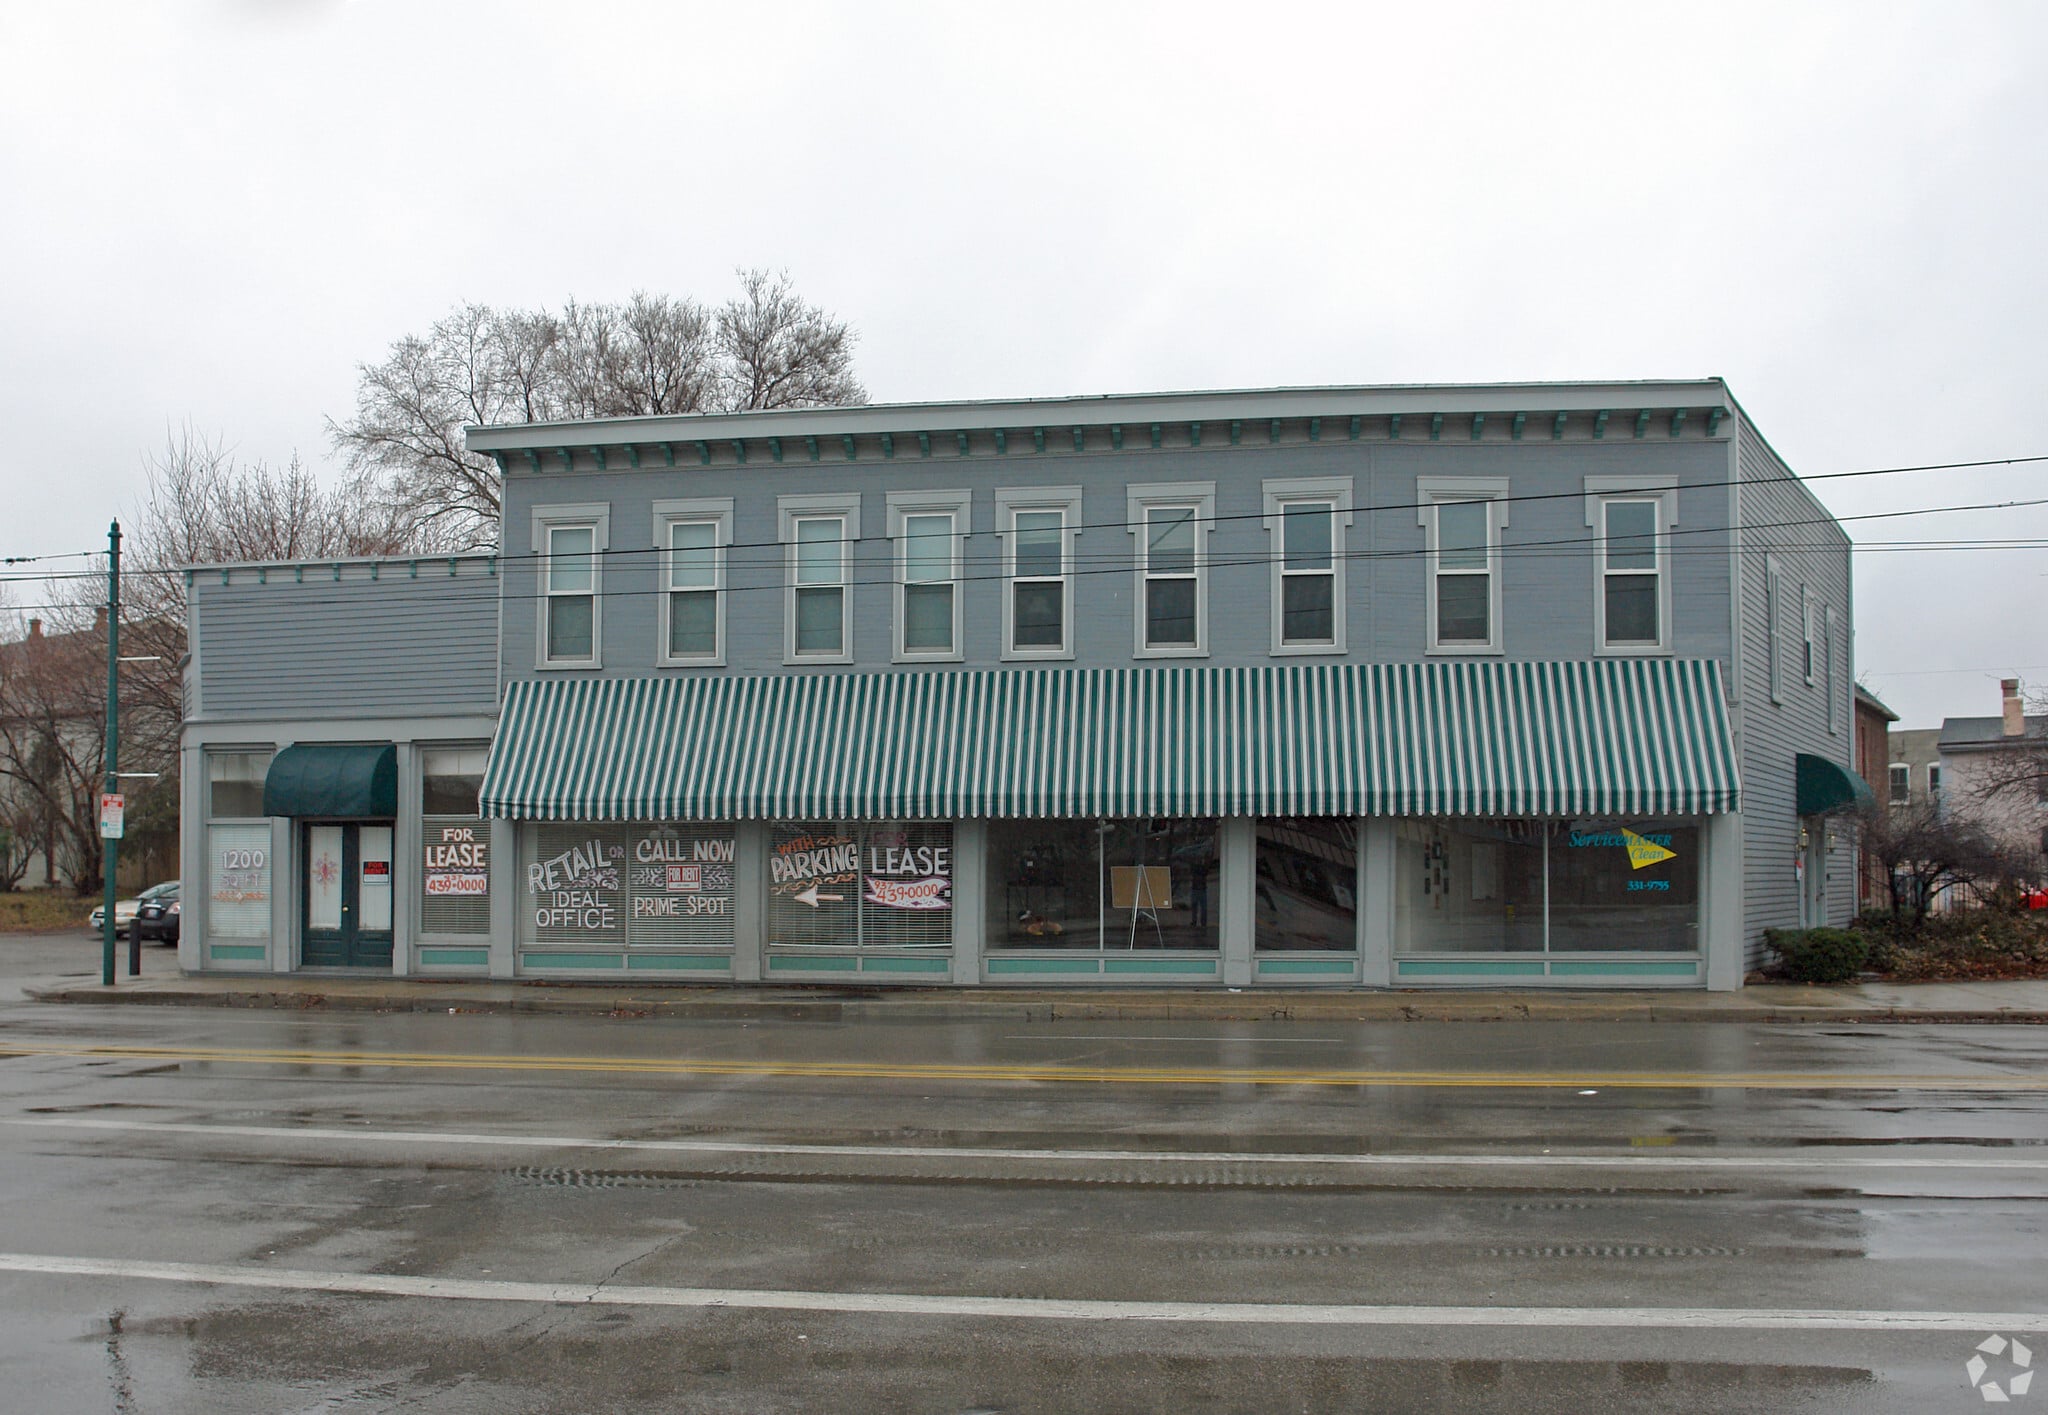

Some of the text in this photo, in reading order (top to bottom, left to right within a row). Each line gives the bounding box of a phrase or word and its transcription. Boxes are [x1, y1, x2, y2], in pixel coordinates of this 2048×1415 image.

[443, 828, 475, 841] FOR
[426, 843, 487, 867] LEASE
[636, 839, 736, 863] CALL NOW
[777, 834, 815, 856] WITH
[1631, 847, 1665, 861] Clean
[223, 849, 264, 869] 1200
[527, 839, 625, 894] RETAIL OR
[770, 843, 859, 883] PARKING
[871, 846, 949, 876] LEASE
[668, 867, 700, 882] FOR RENT
[428, 879, 485, 892] 439-0000
[874, 880, 894, 890] 937
[876, 883, 939, 902] 439-0000
[552, 890, 608, 908] IDEAL
[634, 895, 729, 919] PRIME SPOT
[536, 908, 616, 929] OFFICE
